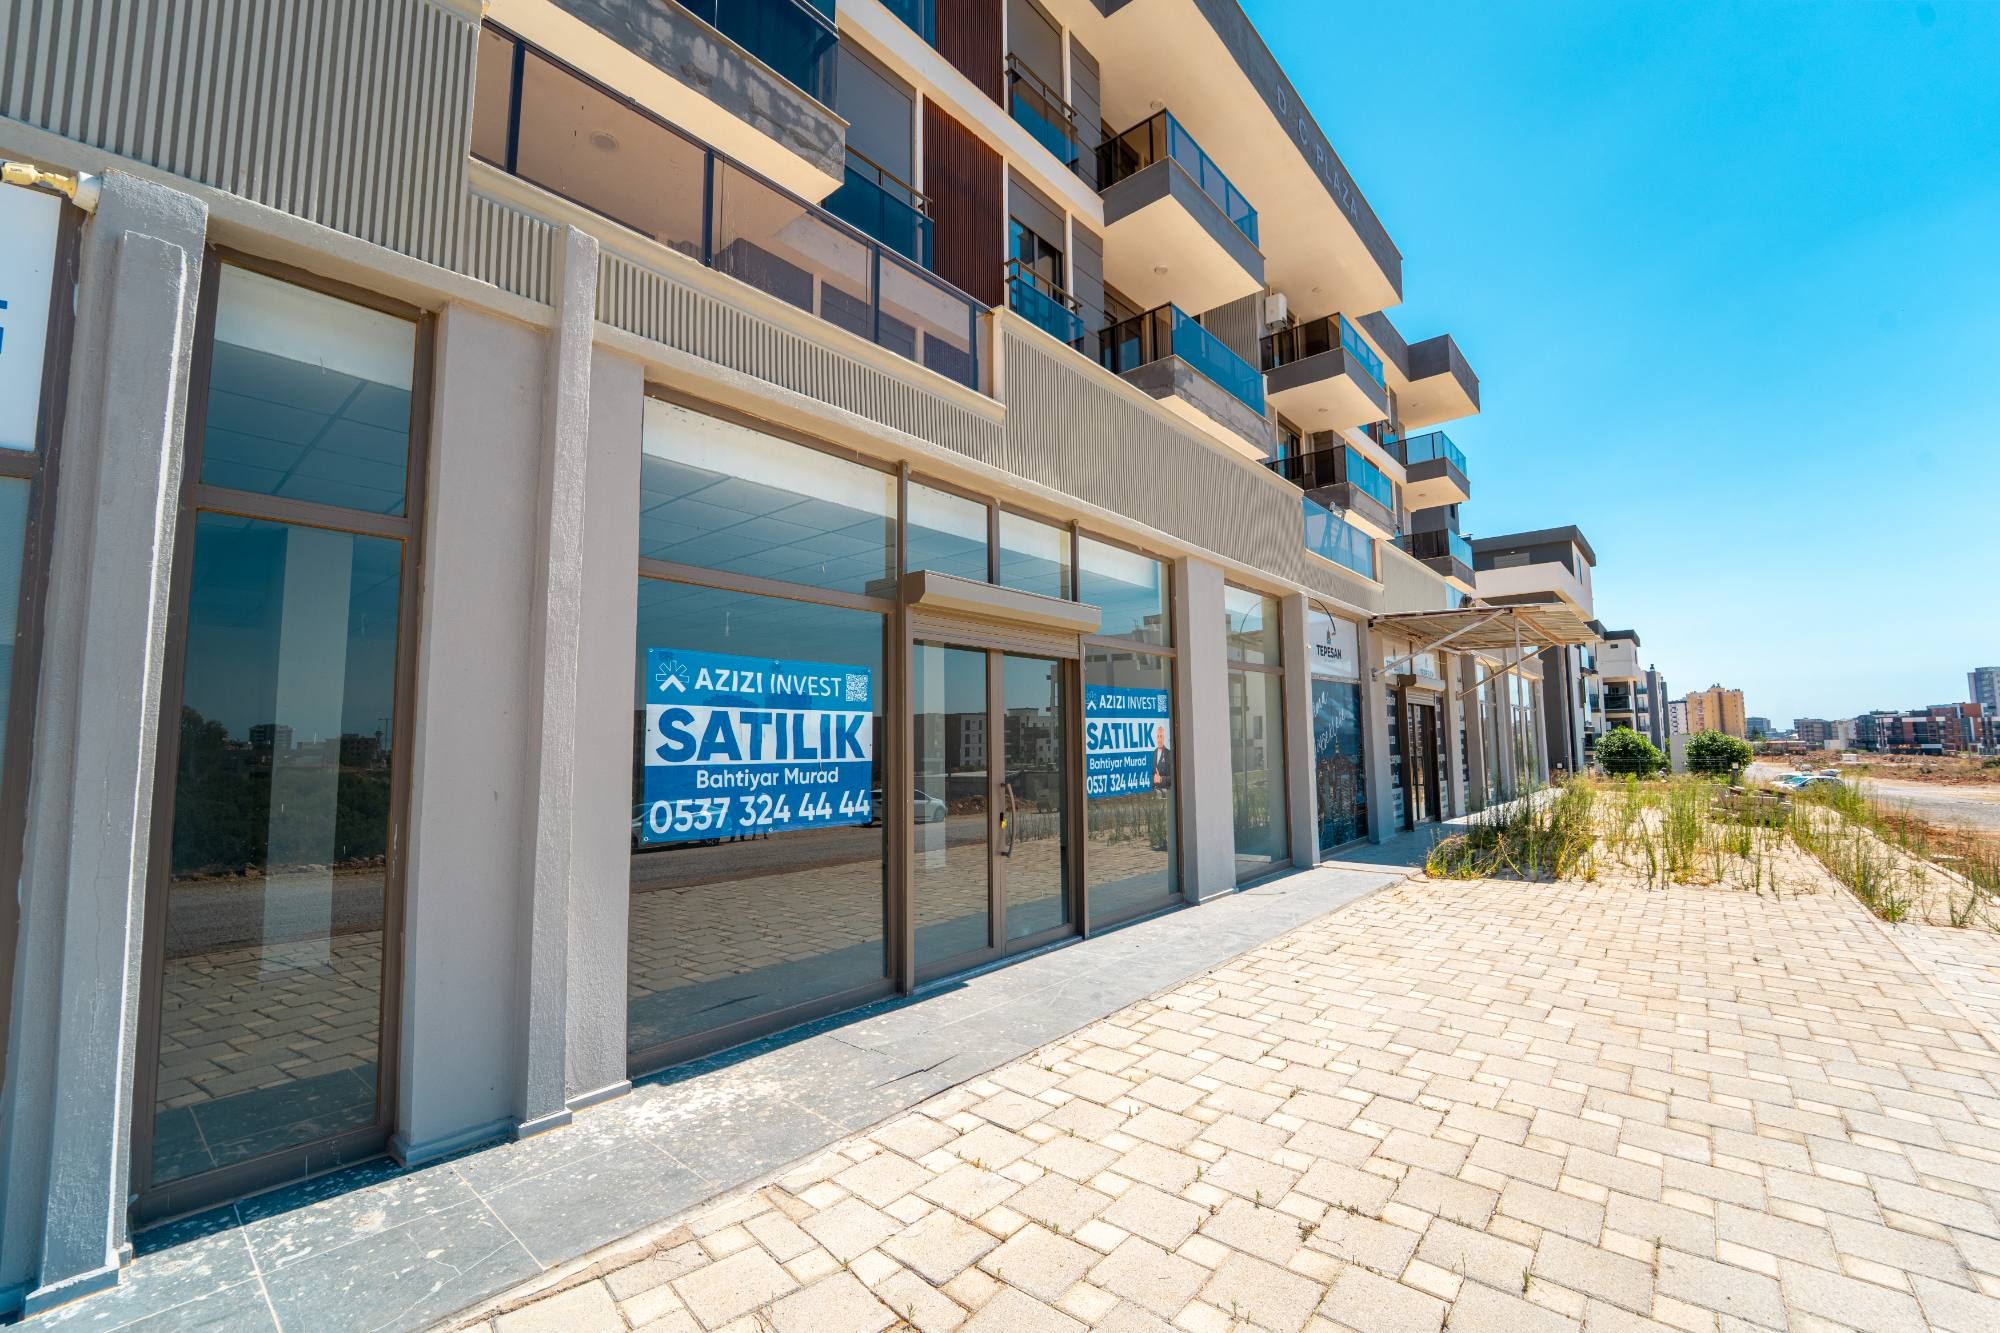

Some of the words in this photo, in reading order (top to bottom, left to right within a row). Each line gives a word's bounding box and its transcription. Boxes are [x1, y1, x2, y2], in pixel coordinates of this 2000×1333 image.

[1277, 84, 1287, 115] D
[1298, 118, 1307, 145] C
[1316, 144, 1358, 221] PLAZA
[1316, 644, 1342, 660] TEPESAN
[694, 668, 763, 693] AZIZI
[770, 674, 842, 697] INVEST
[1100, 694, 1126, 709] AZIZI
[1127, 696, 1156, 710] INVEST
[656, 707, 865, 763] SATILIK
[1086, 722, 1156, 751] SATILIK
[1089, 757, 1123, 771] Bahtiyar
[1124, 755, 1147, 768] Murad
[696, 768, 780, 792] Bahtiyar
[784, 767, 839, 785] Murad
[1086, 774, 1108, 795] 0537
[1110, 773, 1126, 792] 324
[1128, 772, 1138, 789] 44
[1139, 771, 1150, 788] 44
[650, 796, 731, 834] 0537
[739, 793, 791, 827] 324
[799, 791, 833, 821] 44
[838, 789, 870, 818] 44
